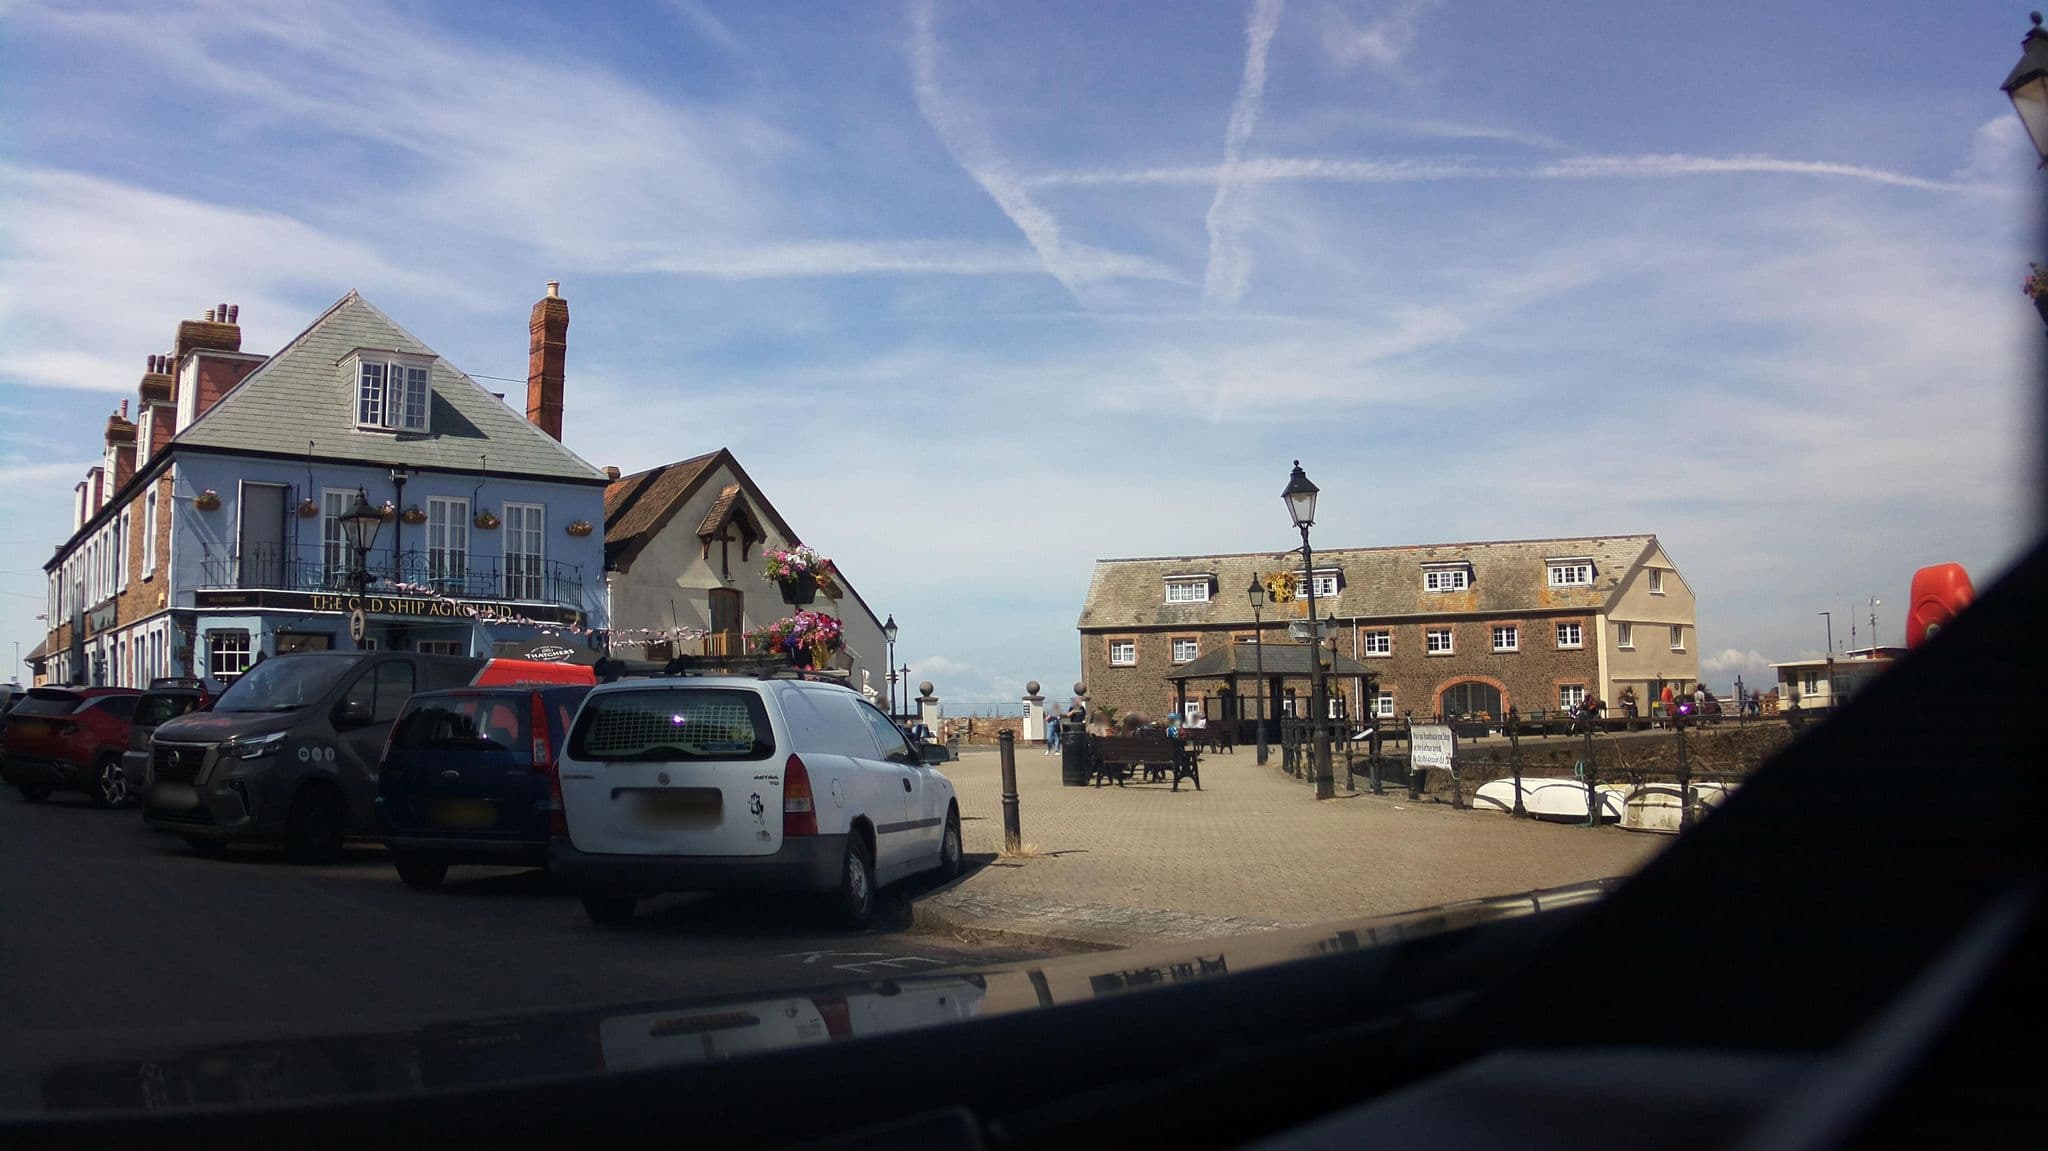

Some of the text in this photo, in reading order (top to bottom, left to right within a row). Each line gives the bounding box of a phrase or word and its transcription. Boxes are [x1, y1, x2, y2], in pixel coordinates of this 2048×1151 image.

[310, 595, 343, 610] THE
[388, 599, 426, 615] SHIP
[524, 647, 576, 659] THATCHERS
